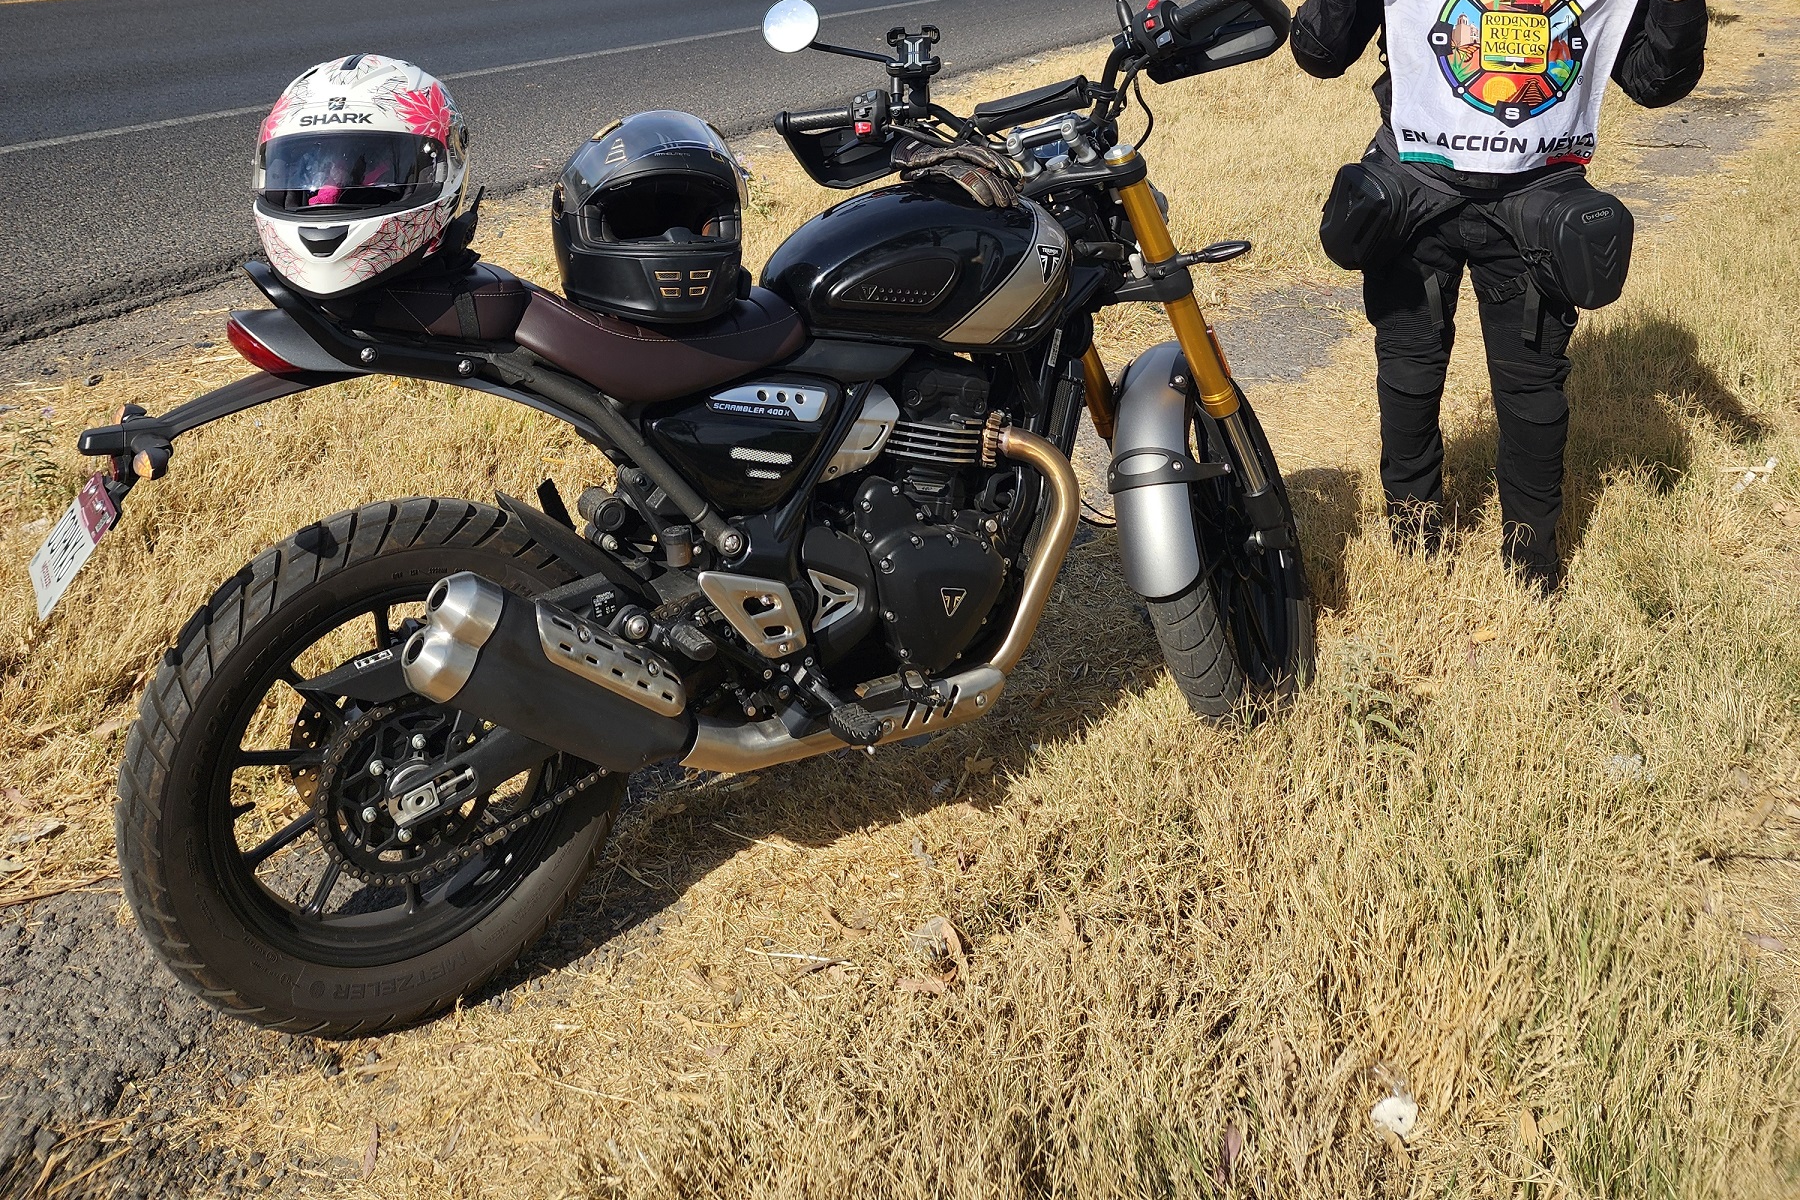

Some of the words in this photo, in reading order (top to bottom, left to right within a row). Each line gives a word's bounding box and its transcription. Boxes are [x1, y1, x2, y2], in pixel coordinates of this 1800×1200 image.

[1431, 33, 1448, 45] O
[1571, 37, 1583, 50] E
[299, 112, 374, 127] SHARK
[1504, 107, 1520, 120] S
[1401, 128, 1427, 145] EN
[1436, 131, 1528, 154] ACCIÓN
[712, 402, 765, 414] SCRAMBLER
